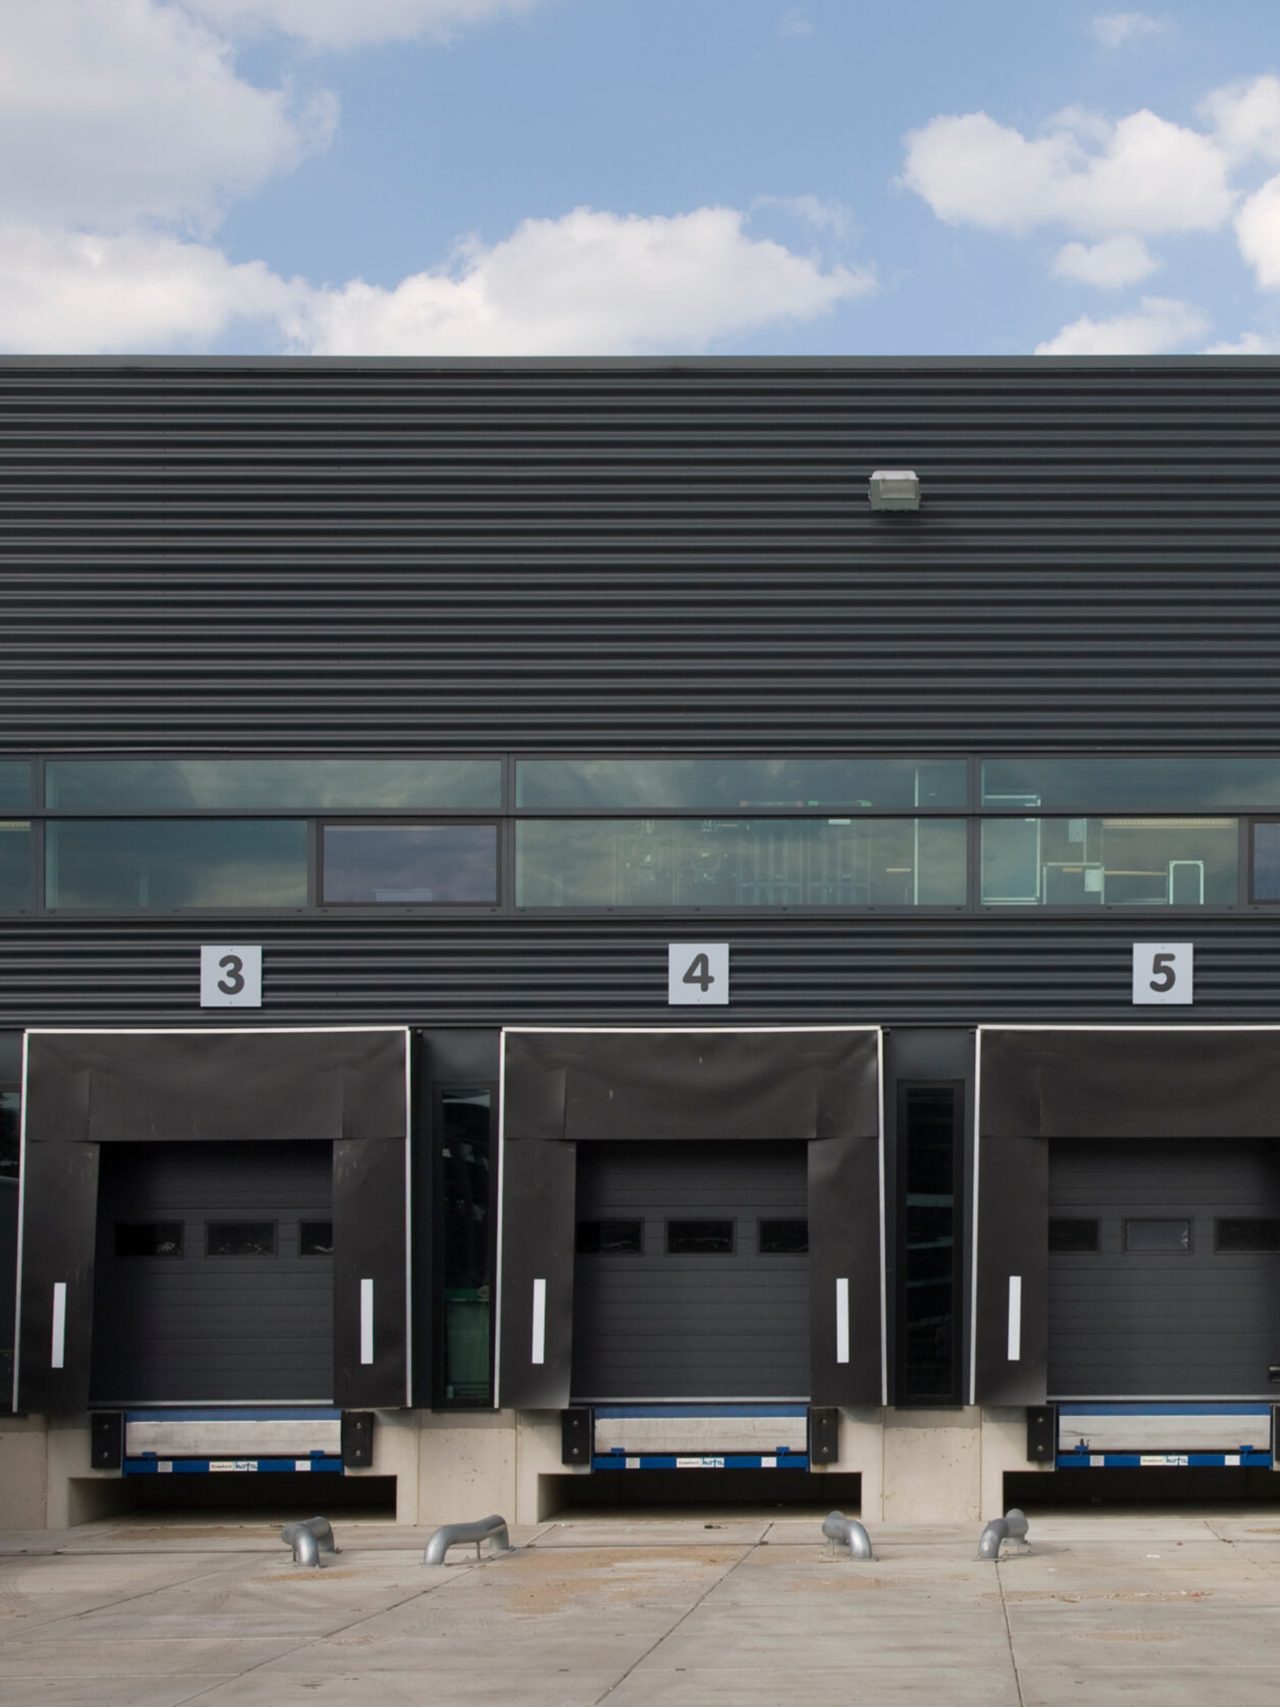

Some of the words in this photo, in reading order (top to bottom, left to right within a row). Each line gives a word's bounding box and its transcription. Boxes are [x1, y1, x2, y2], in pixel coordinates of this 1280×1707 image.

[217, 954, 245, 995] 3
[682, 953, 715, 992] 4
[1149, 953, 1176, 993] 5
